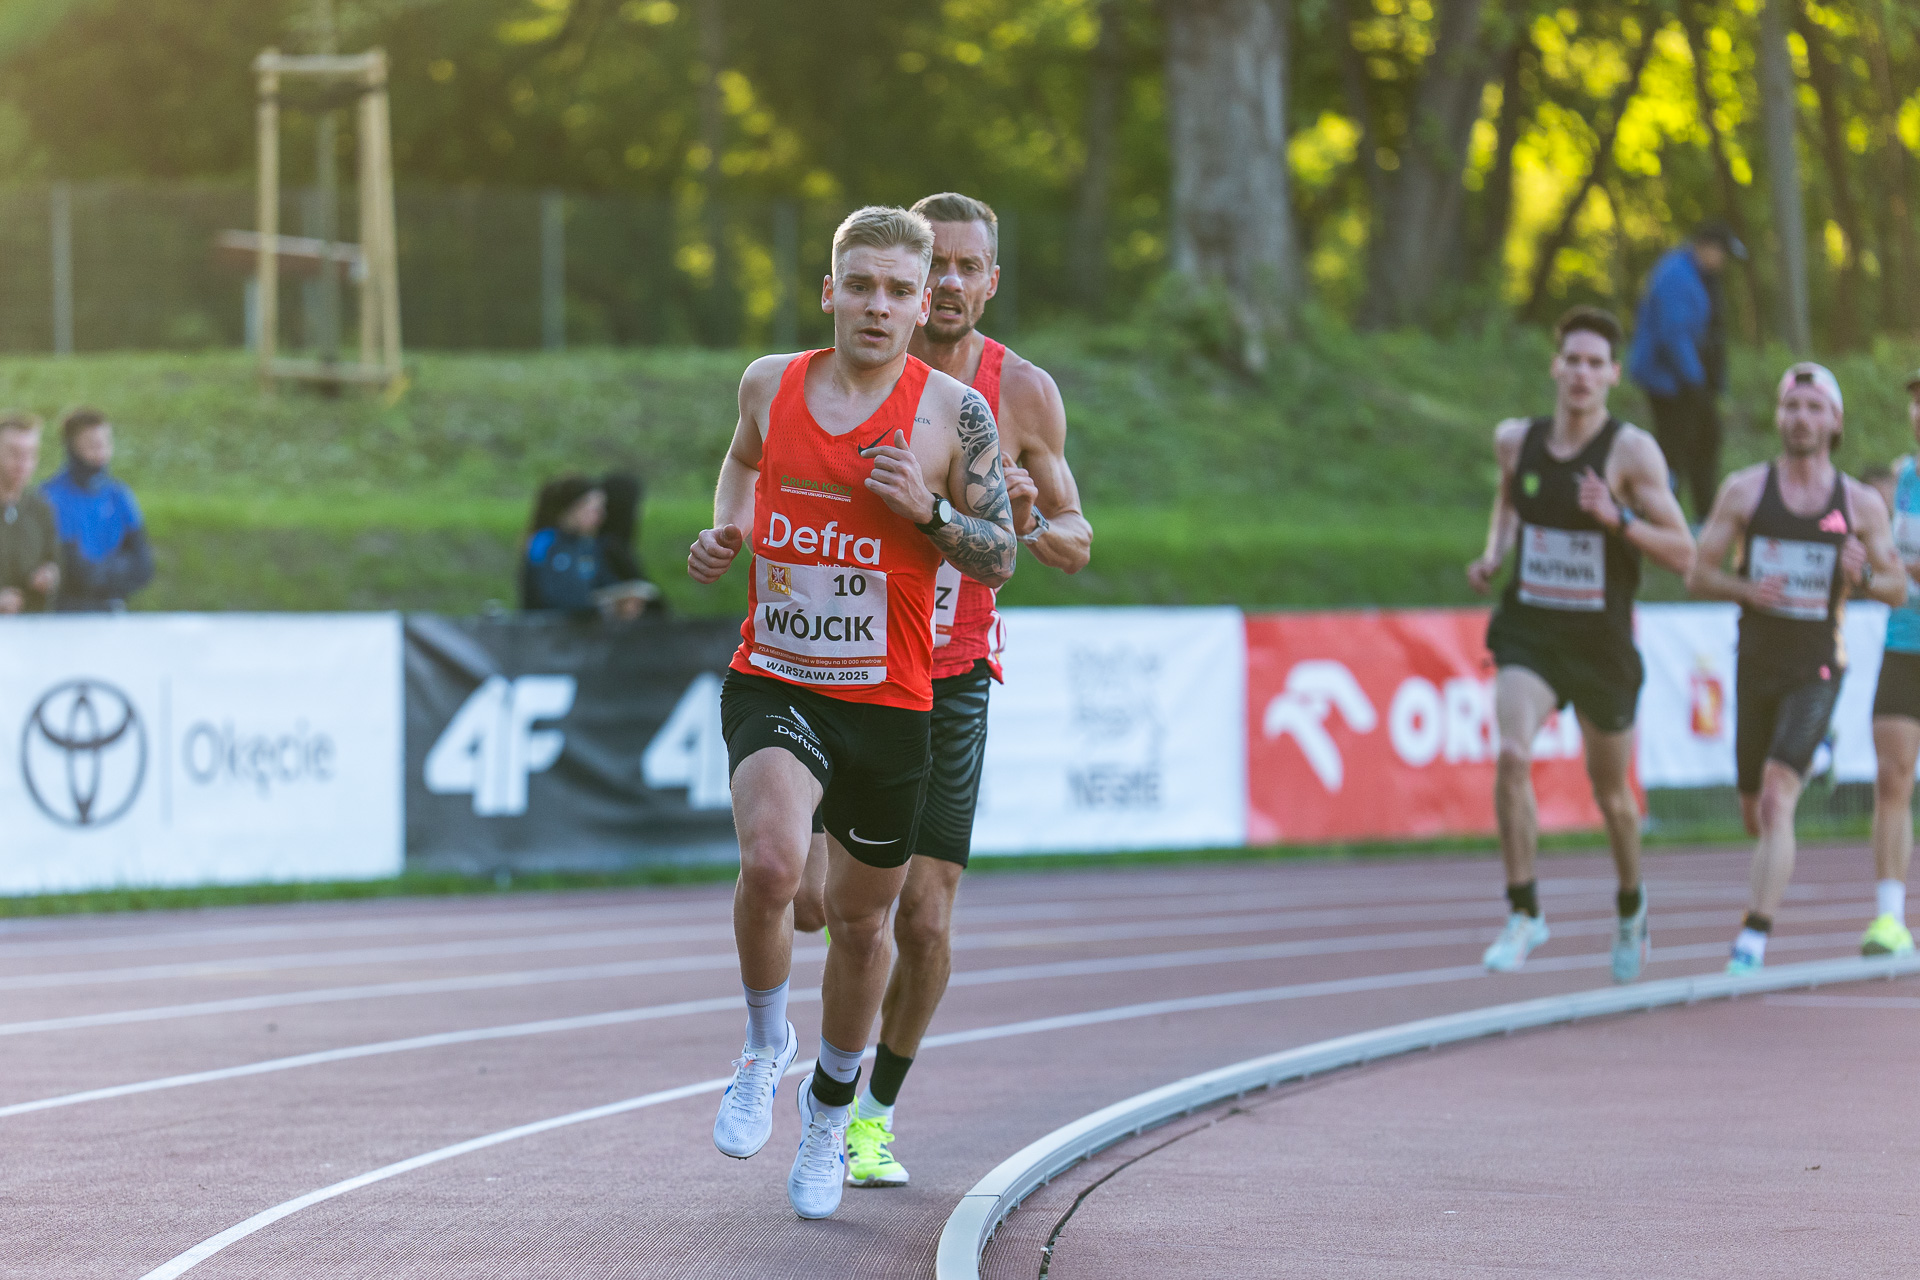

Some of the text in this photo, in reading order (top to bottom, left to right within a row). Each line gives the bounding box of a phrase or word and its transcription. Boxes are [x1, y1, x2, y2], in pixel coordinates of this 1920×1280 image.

[781, 475, 853, 496] GRUPA KOSZ
[833, 574, 867, 597] 10
[765, 604, 875, 642] WÓJCIK
[766, 660, 869, 681] WARSZAWA 2025
[180, 717, 338, 799] Okęcie
[423, 673, 578, 817] 4F
